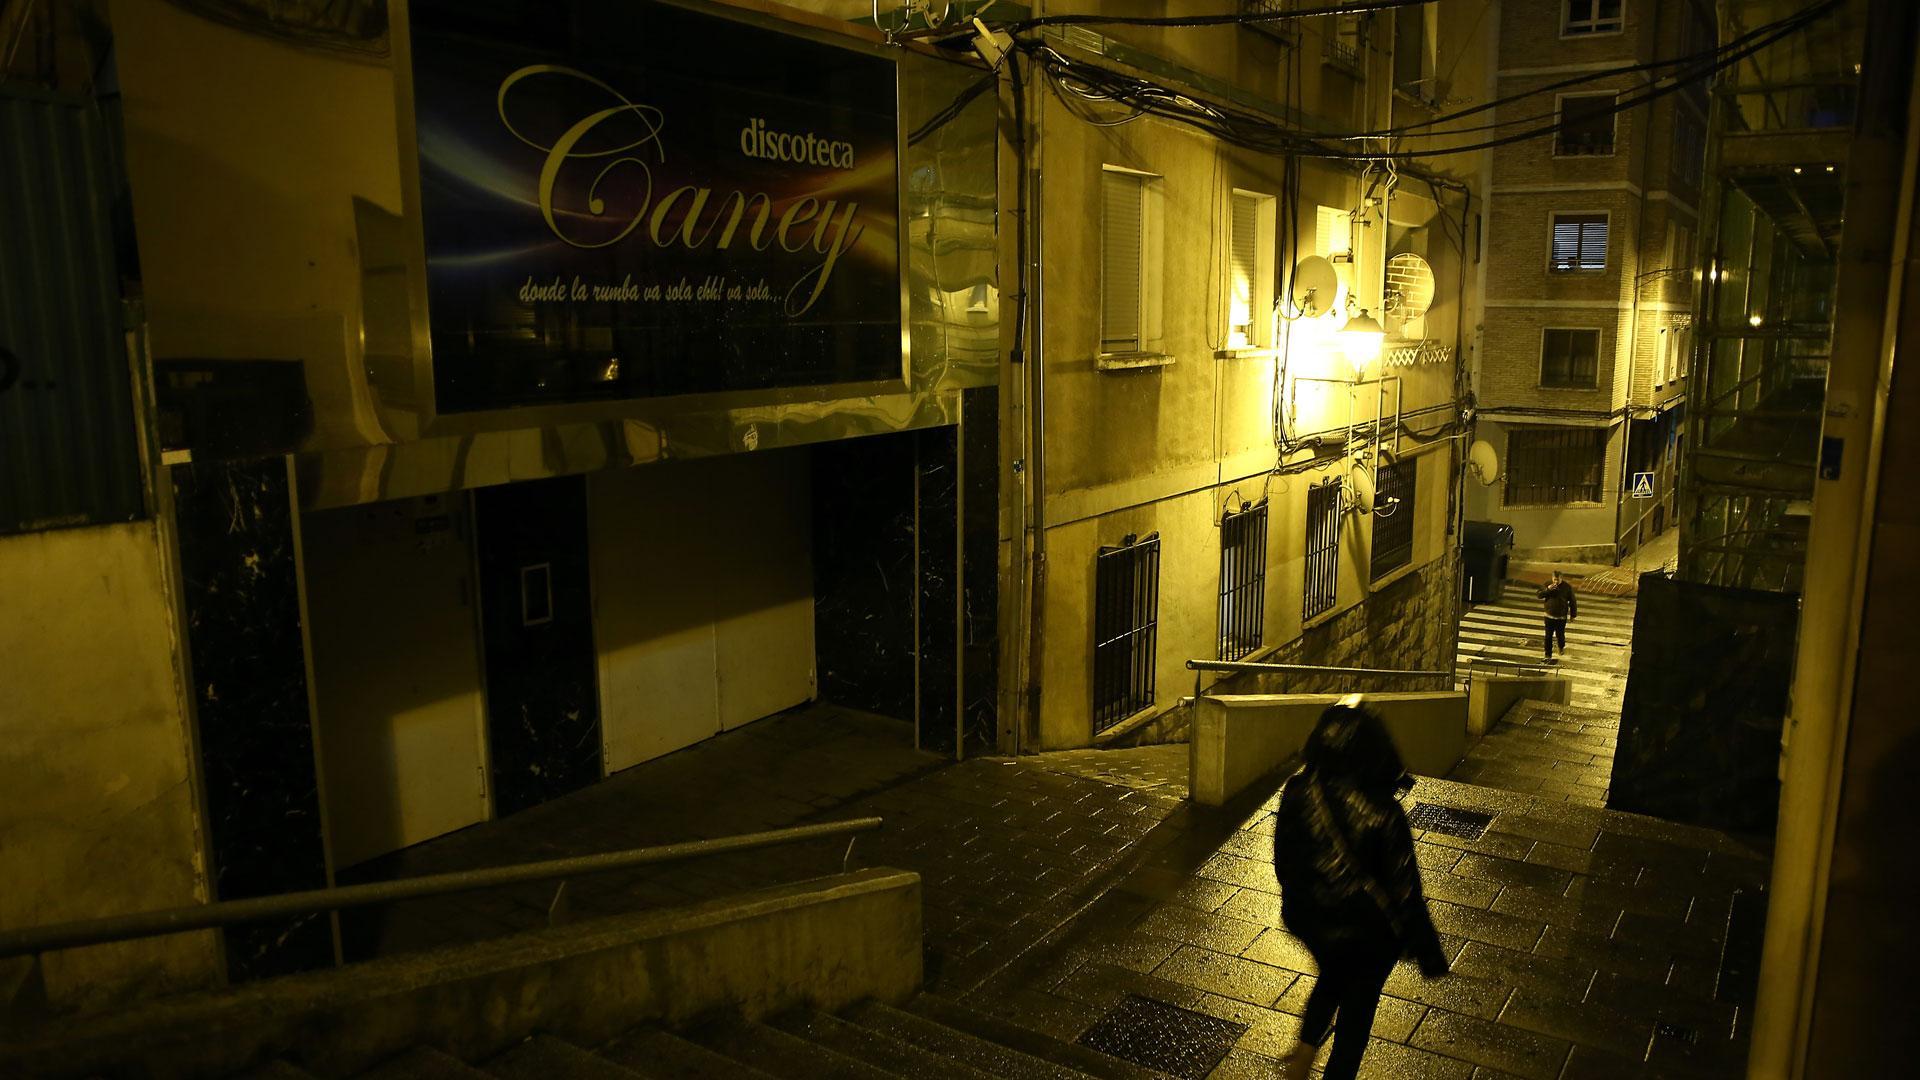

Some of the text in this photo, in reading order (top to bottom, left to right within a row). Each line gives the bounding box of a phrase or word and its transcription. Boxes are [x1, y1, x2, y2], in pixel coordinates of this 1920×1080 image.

[740, 117, 855, 169] discoteca
[497, 64, 866, 318] Caney
[519, 274, 567, 302] donde
[570, 274, 589, 301] la
[591, 272, 639, 302] rumba
[643, 283, 662, 301] va
[664, 275, 693, 301] sola
[726, 284, 743, 301] va
